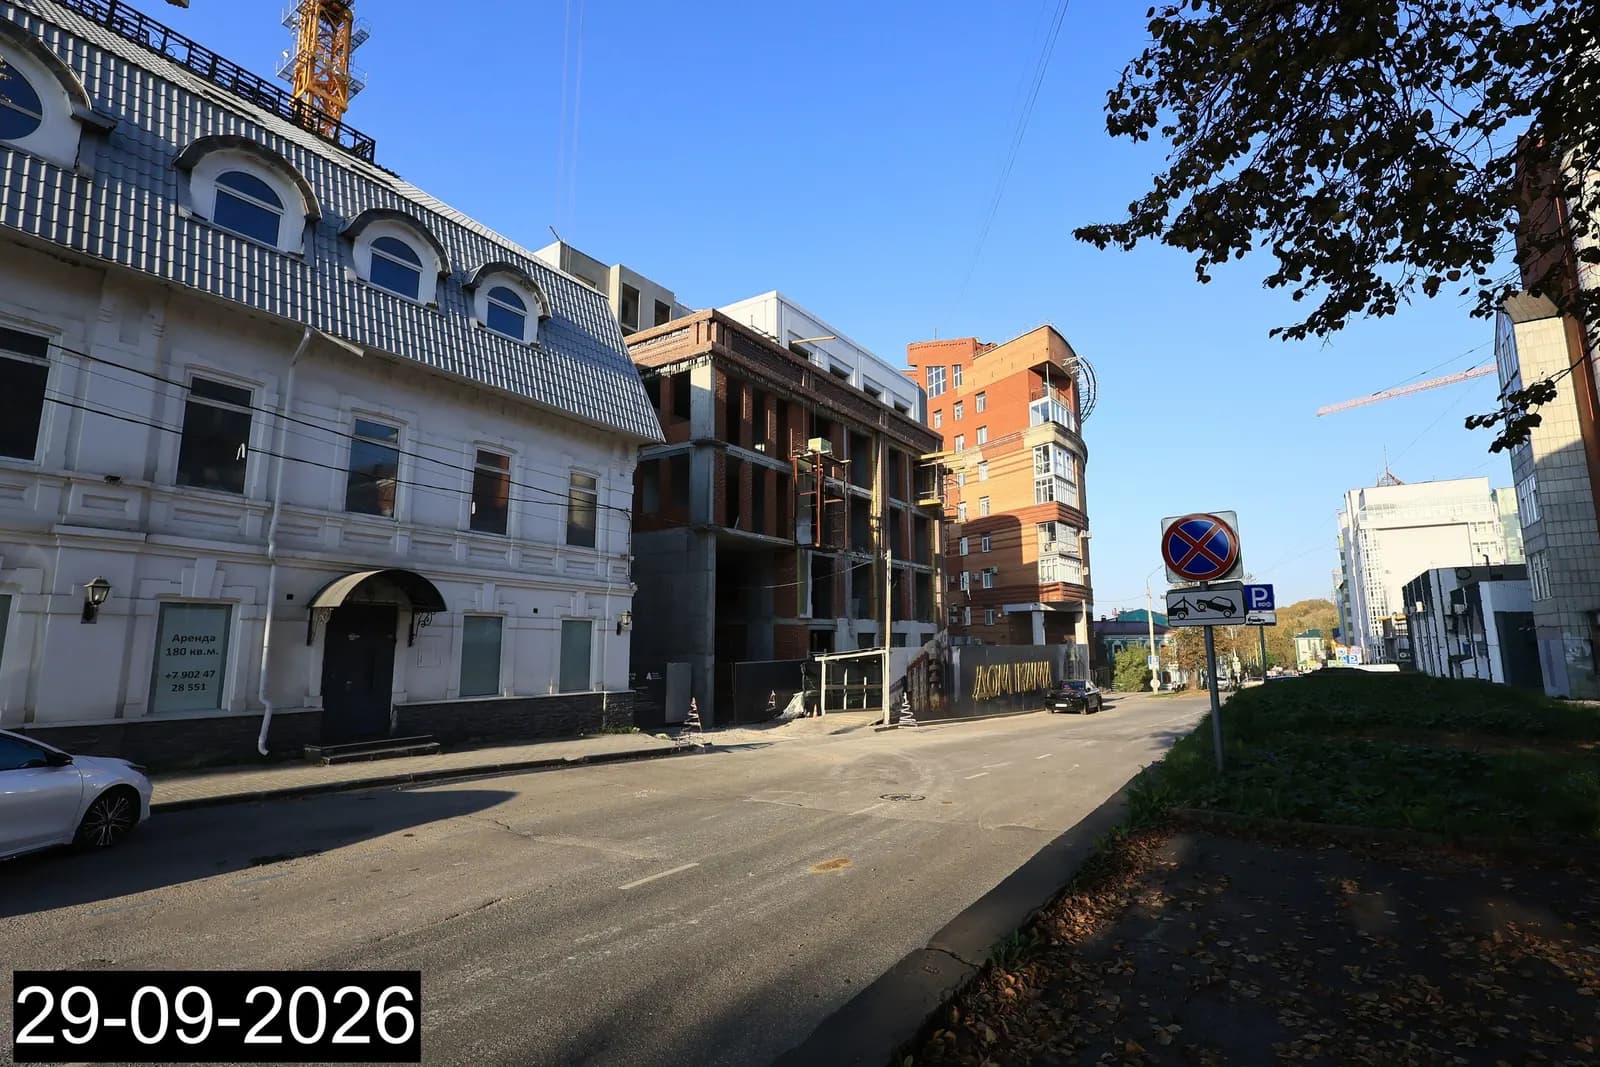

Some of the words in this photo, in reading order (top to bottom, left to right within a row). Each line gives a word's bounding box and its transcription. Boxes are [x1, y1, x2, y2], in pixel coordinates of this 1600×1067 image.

[1251, 587, 1268, 608] P
[172, 634, 216, 644] Аренда
[166, 647, 187, 656] 180
[189, 648, 219, 656] кв.м.
[165, 671, 179, 679] +7
[180, 671, 201, 679] 902
[202, 669, 216, 678] 47
[171, 683, 185, 692] 28
[187, 682, 206, 692] 551
[972, 664, 1012, 701] ДОМ
